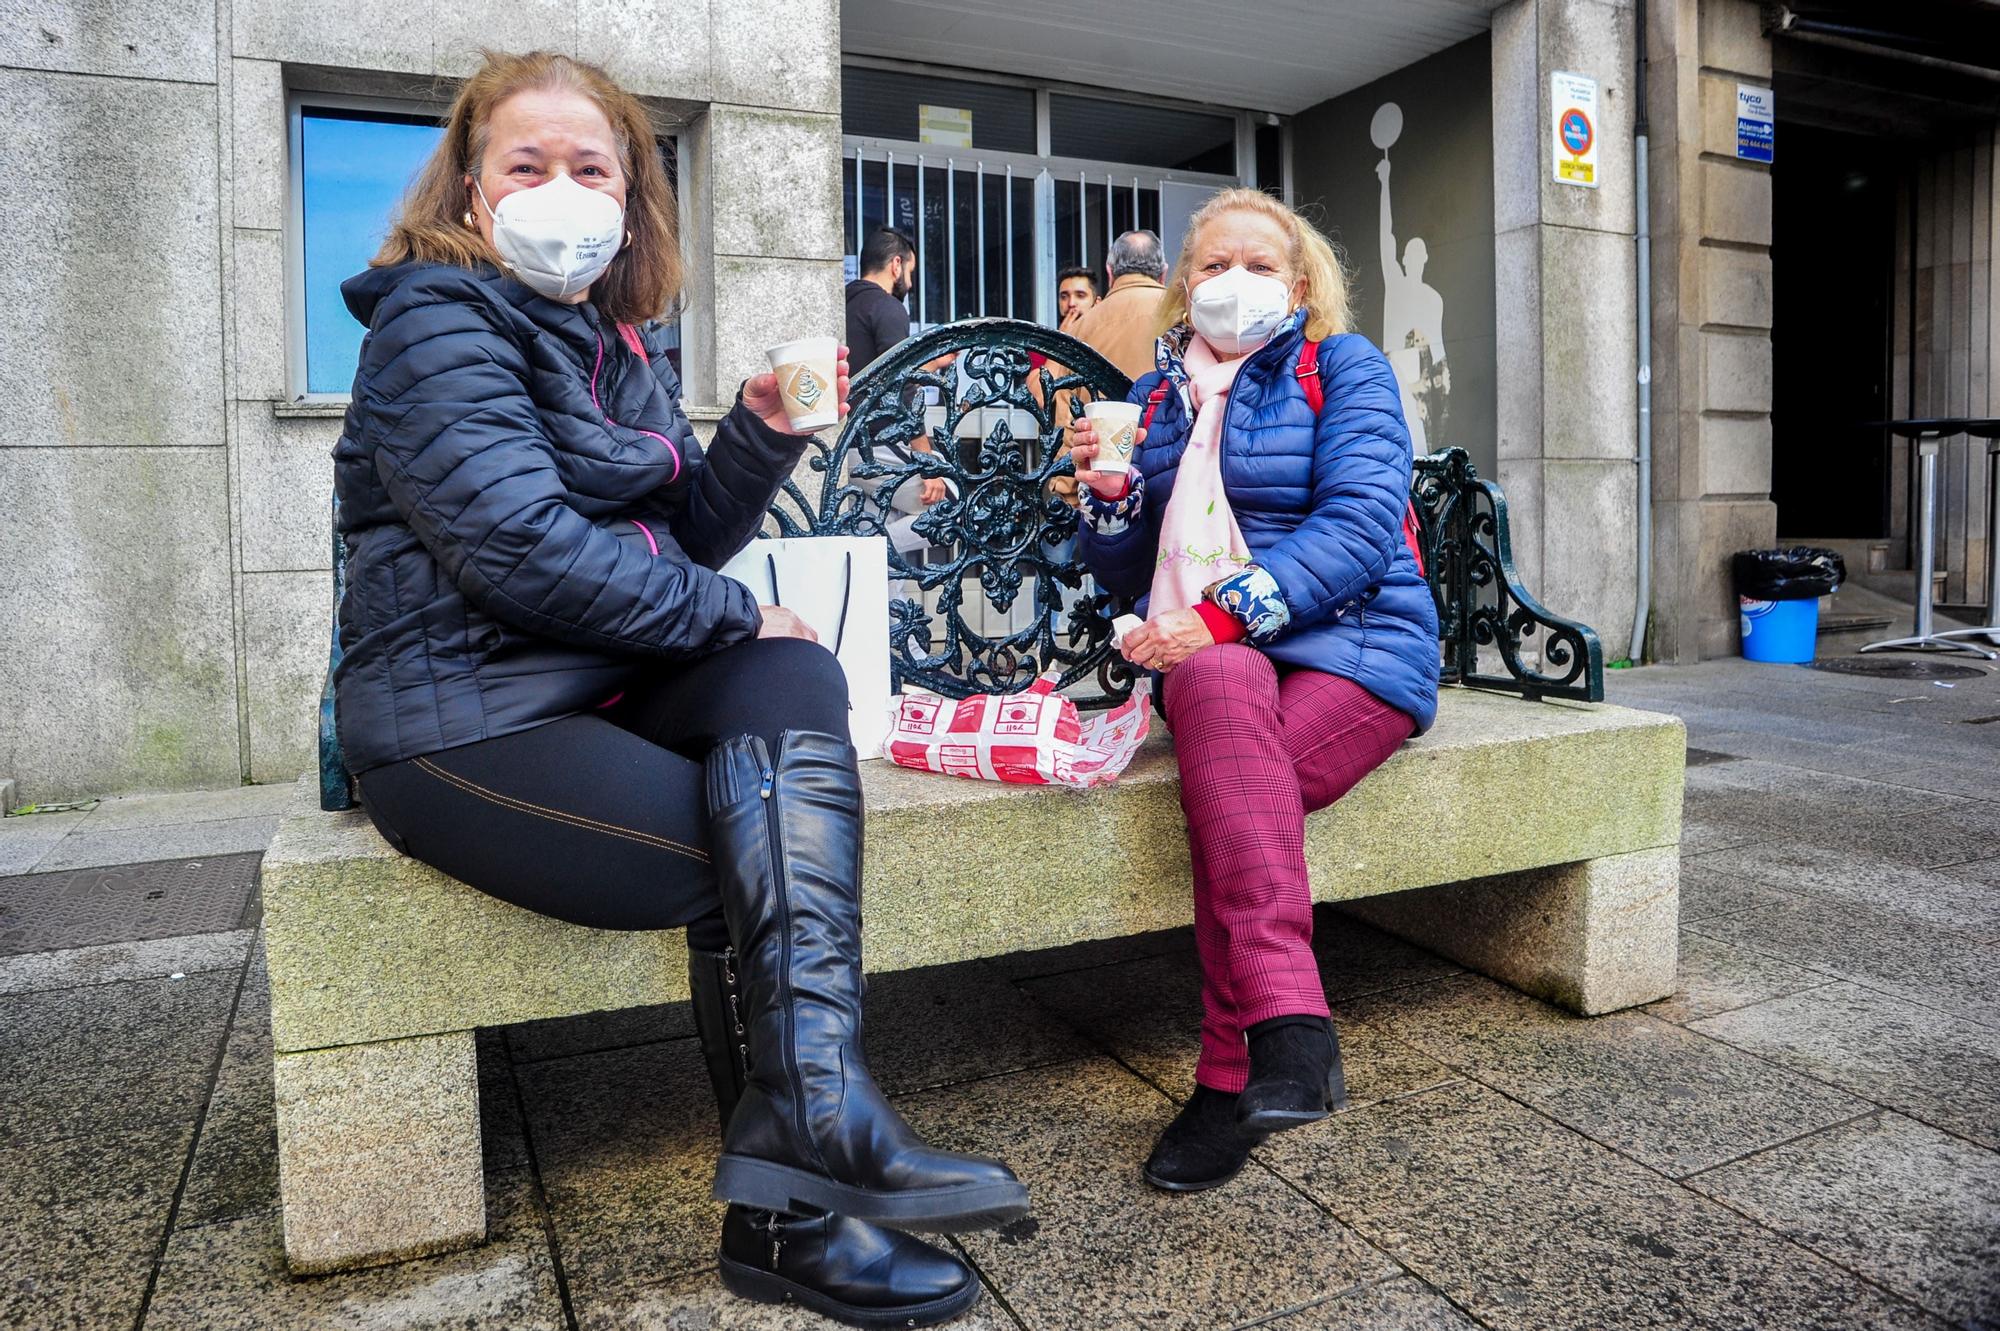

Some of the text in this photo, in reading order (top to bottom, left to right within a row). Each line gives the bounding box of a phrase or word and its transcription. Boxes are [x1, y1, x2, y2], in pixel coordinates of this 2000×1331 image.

[1739, 91, 1762, 104] tyco
[1739, 120, 1763, 133] Alarma
[907, 723, 922, 731] yoli
[1006, 724, 1024, 732] yoli
